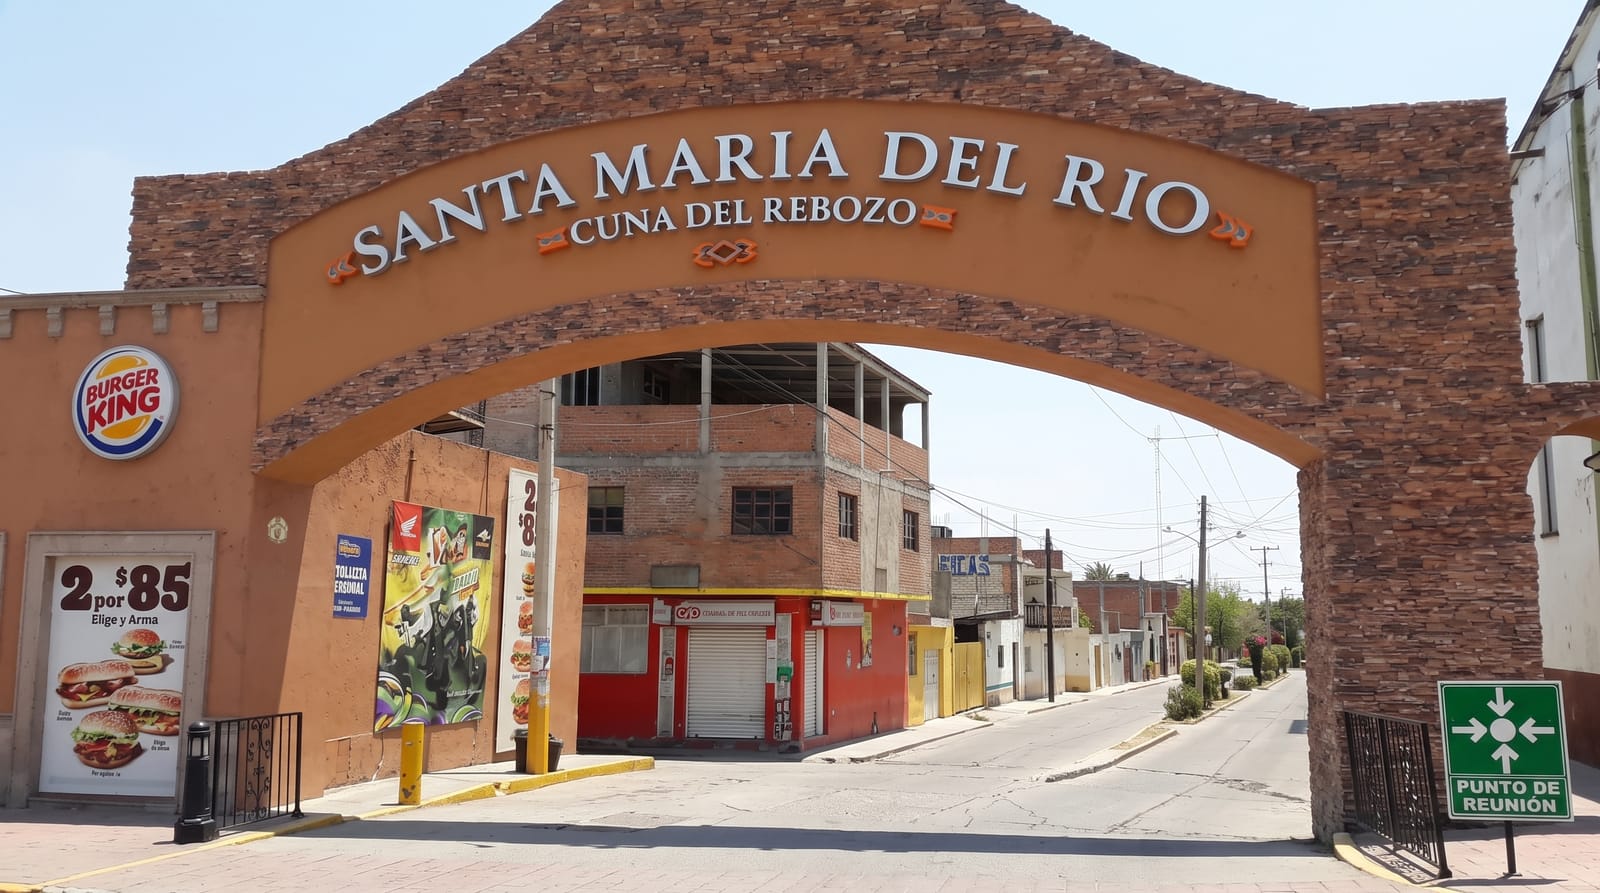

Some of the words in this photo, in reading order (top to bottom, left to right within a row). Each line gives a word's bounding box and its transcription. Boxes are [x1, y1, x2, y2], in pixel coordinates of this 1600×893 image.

[352, 162, 577, 277] SANTA
[590, 127, 849, 200] MARIA
[878, 130, 1028, 197] DEL
[1052, 153, 1211, 236] RIO
[569, 205, 678, 247] CUNA
[685, 198, 753, 229] DEL
[763, 195, 918, 226] REBOZO
[85, 367, 160, 406] BURGER
[87, 385, 161, 434] KING
[518, 512, 537, 547] $8
[60, 564, 93, 611] 2
[94, 595, 125, 612] por
[115, 561, 192, 612] $85
[91, 614, 118, 627] Elige
[119, 616, 127, 627] y
[128, 614, 159, 625] Arma
[1456, 779, 1528, 795] PUNTO
[1533, 781, 1561, 795] DE
[1463, 796, 1557, 813] REUNIÓN
